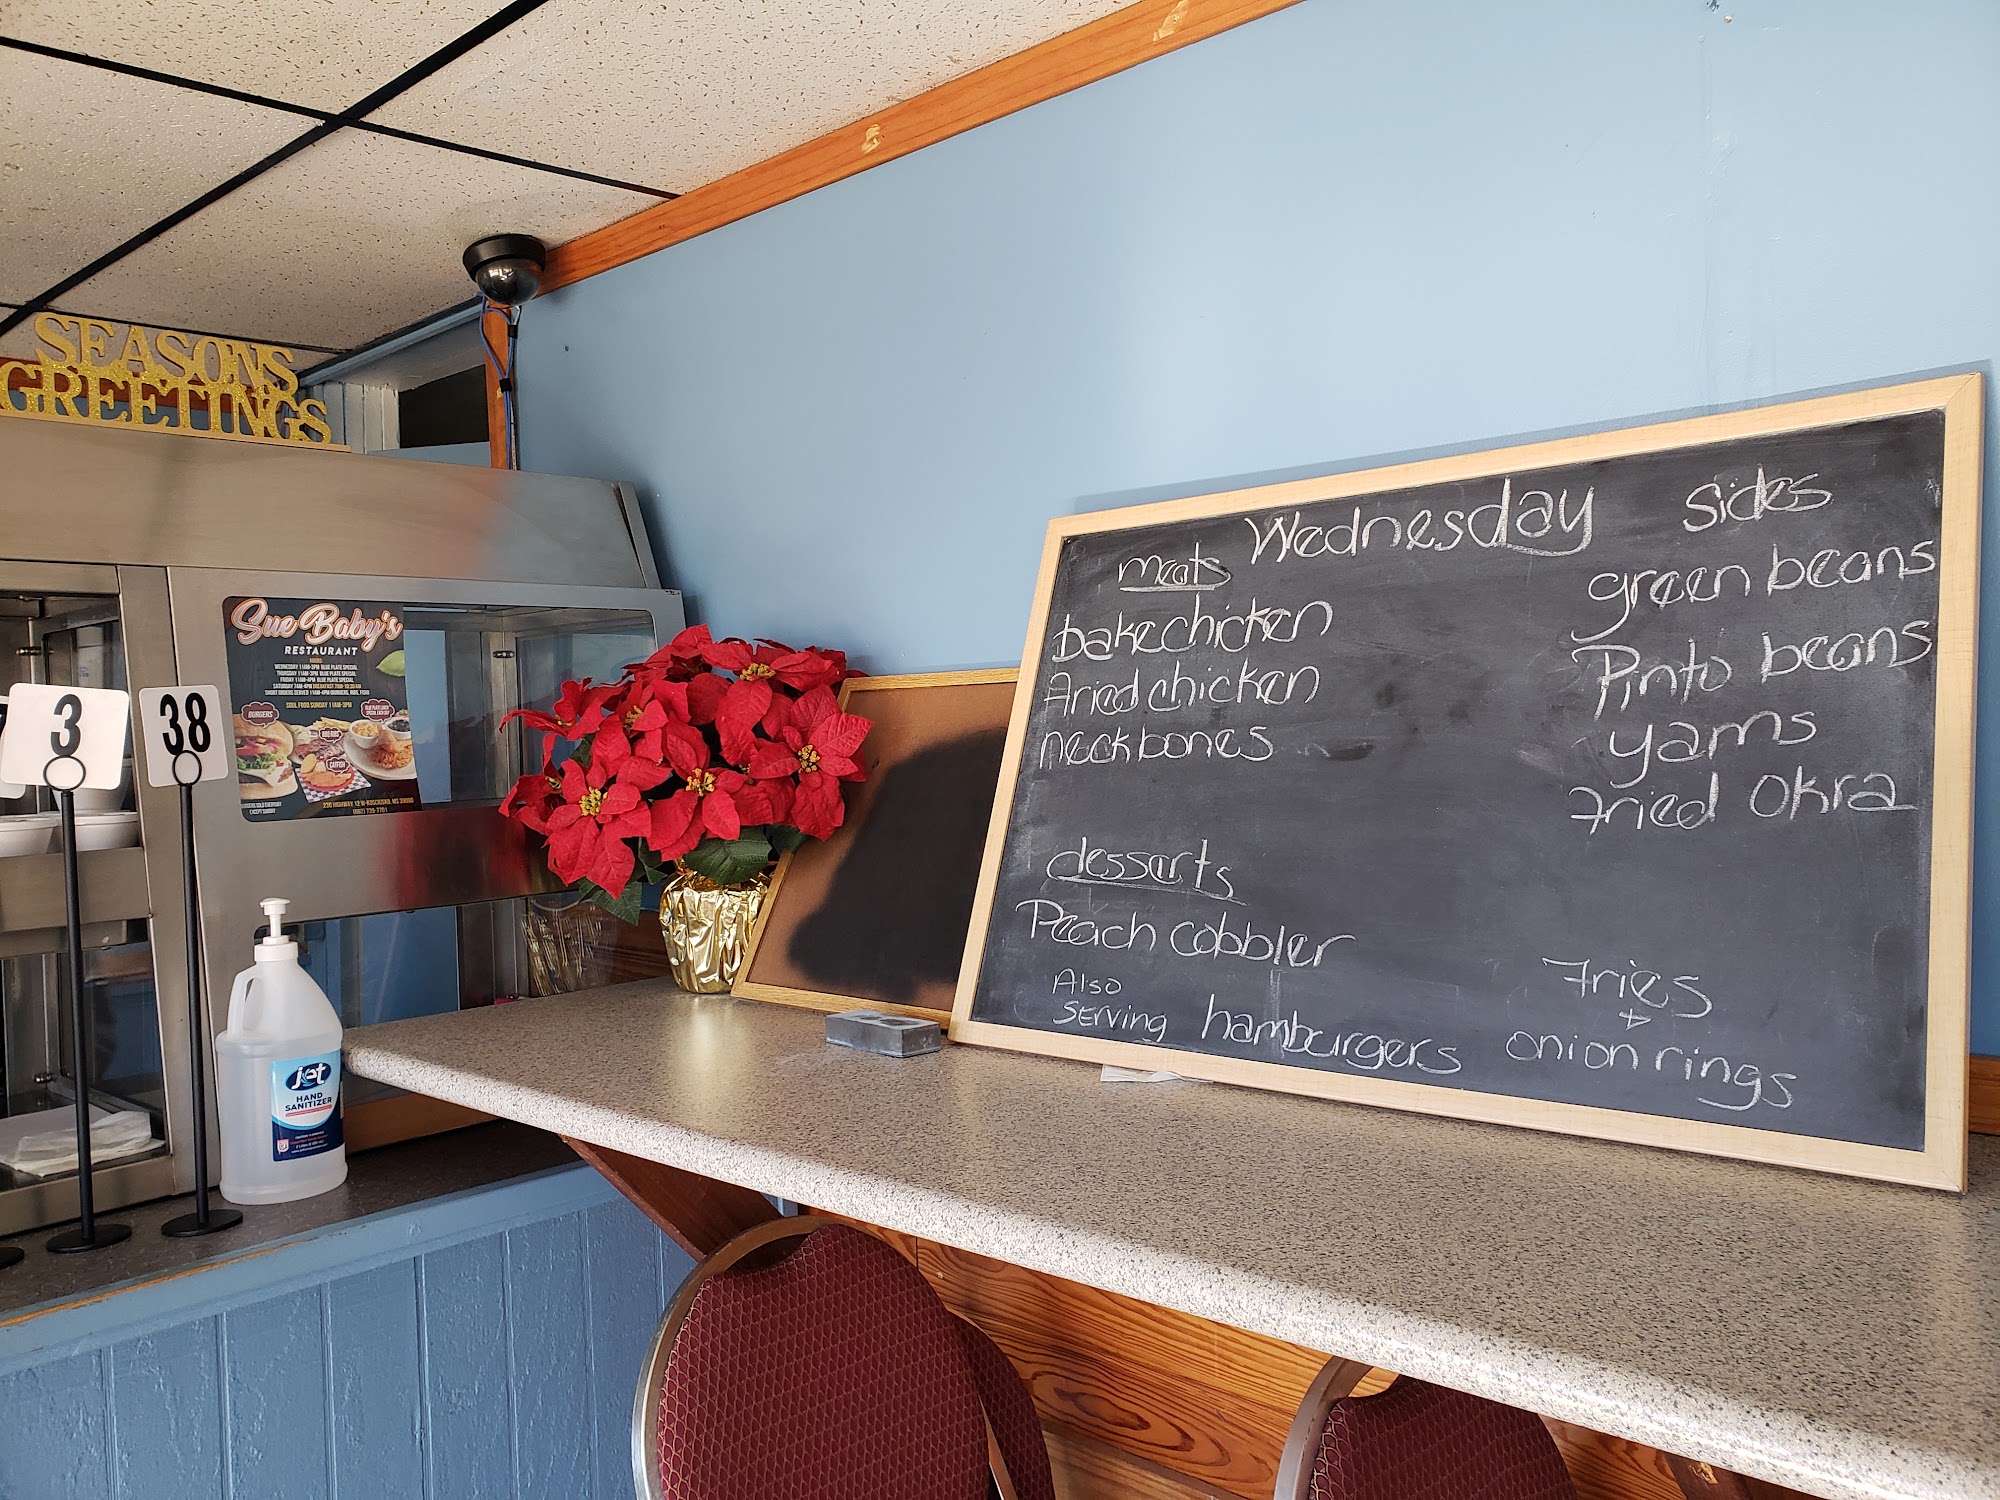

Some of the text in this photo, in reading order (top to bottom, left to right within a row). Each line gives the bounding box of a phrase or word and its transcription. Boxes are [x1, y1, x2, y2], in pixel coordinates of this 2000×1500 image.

[33, 311, 299, 399] SEASONS
[0, 360, 332, 445] GREETINGS
[1244, 477, 1595, 557] Wednesday
[1117, 542, 1232, 591] meats
[1571, 540, 1937, 643] green beans
[231, 598, 403, 653] Sue Baby's
[284, 645, 358, 656] RESTAURANT
[1761, 620, 1934, 684] beans
[248, 710, 274, 719] BURGERS
[1148, 658, 1321, 713] chicken
[50, 693, 83, 756] 3
[159, 692, 211, 756] 38
[1609, 710, 1817, 789] yams
[329, 760, 346, 769] CATFISH
[1015, 899, 1356, 968] Peach cobbler
[1051, 968, 1123, 996] Also
[1201, 993, 1462, 1075] hamburgers
[284, 1096, 333, 1112] SANITIZER
[291, 1062, 327, 1090] jet
[296, 1091, 323, 1103] HAND
[1654, 1046, 1798, 1111] rings
